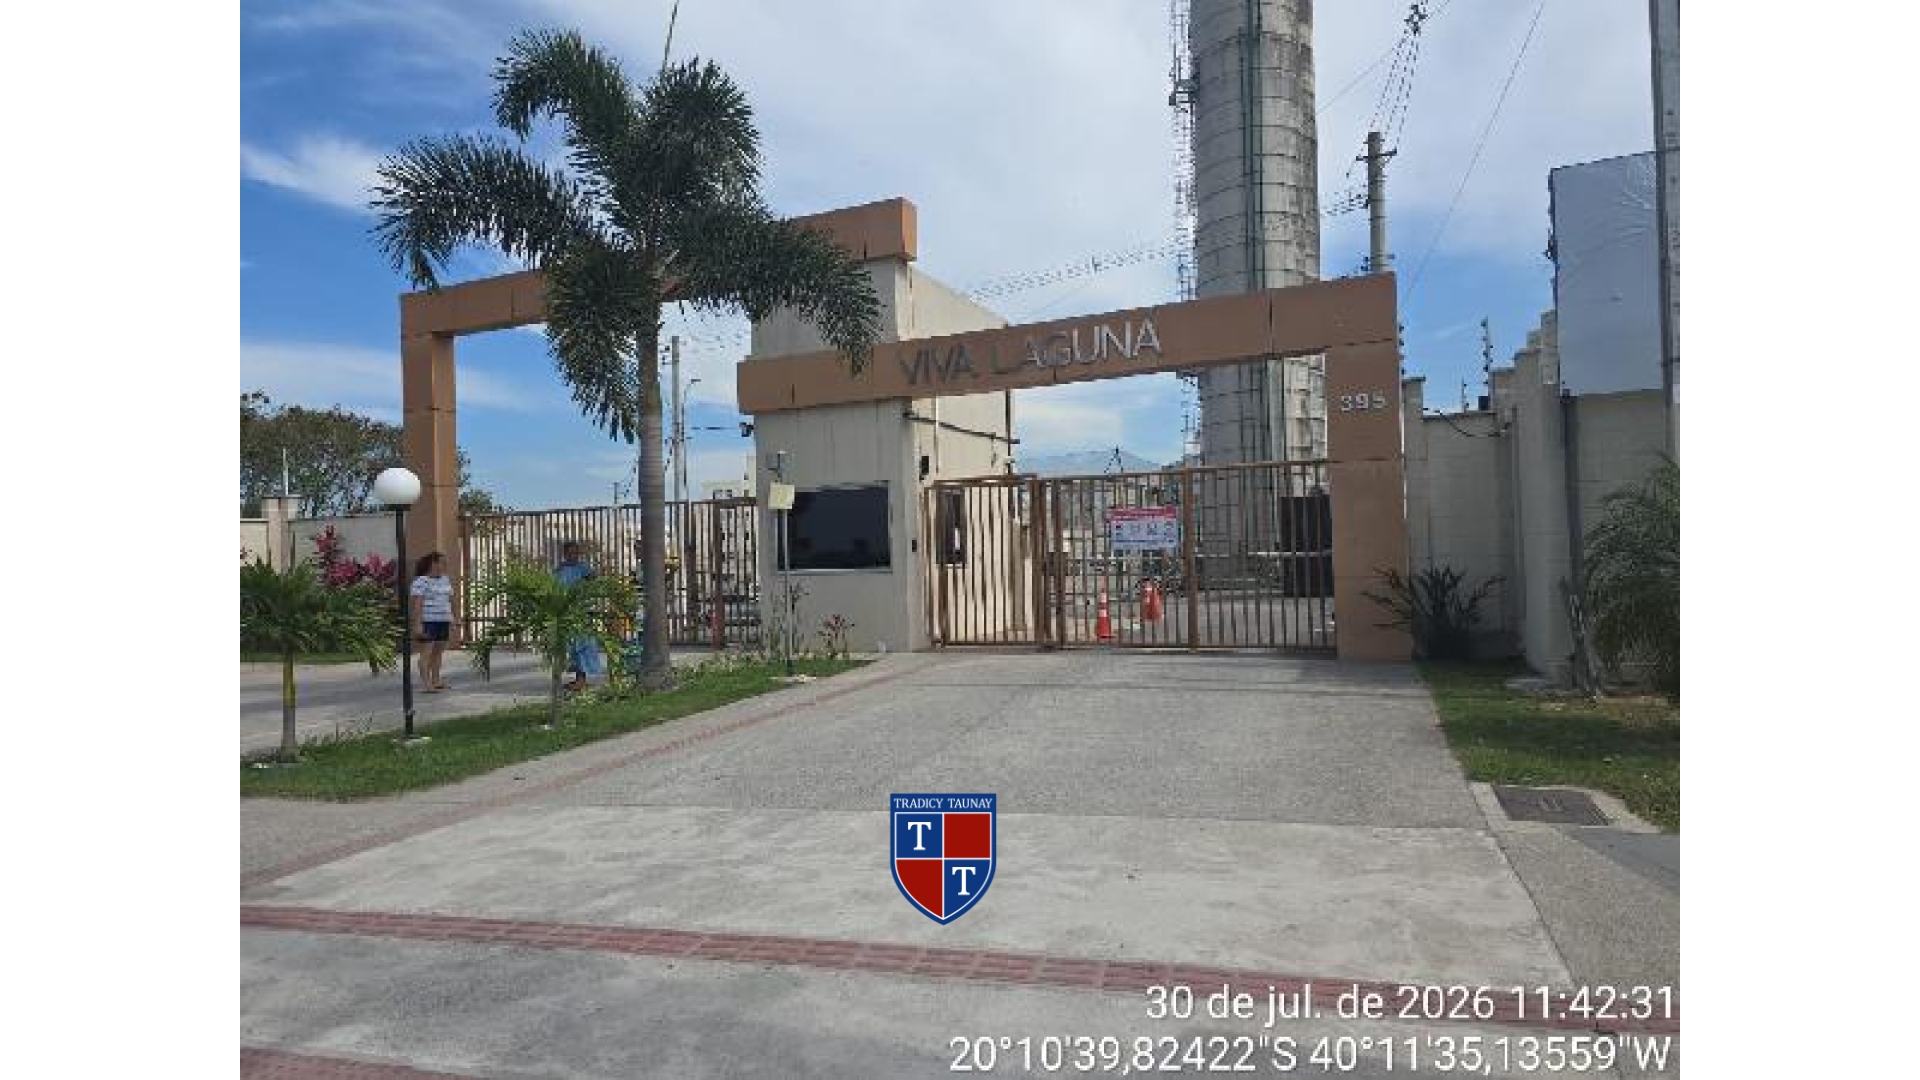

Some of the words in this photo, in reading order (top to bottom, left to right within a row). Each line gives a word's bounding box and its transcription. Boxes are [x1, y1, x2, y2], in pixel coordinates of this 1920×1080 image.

[899, 341, 979, 386] VIVA
[990, 318, 1162, 376] LAGUNA
[1340, 392, 1386, 411] 395
